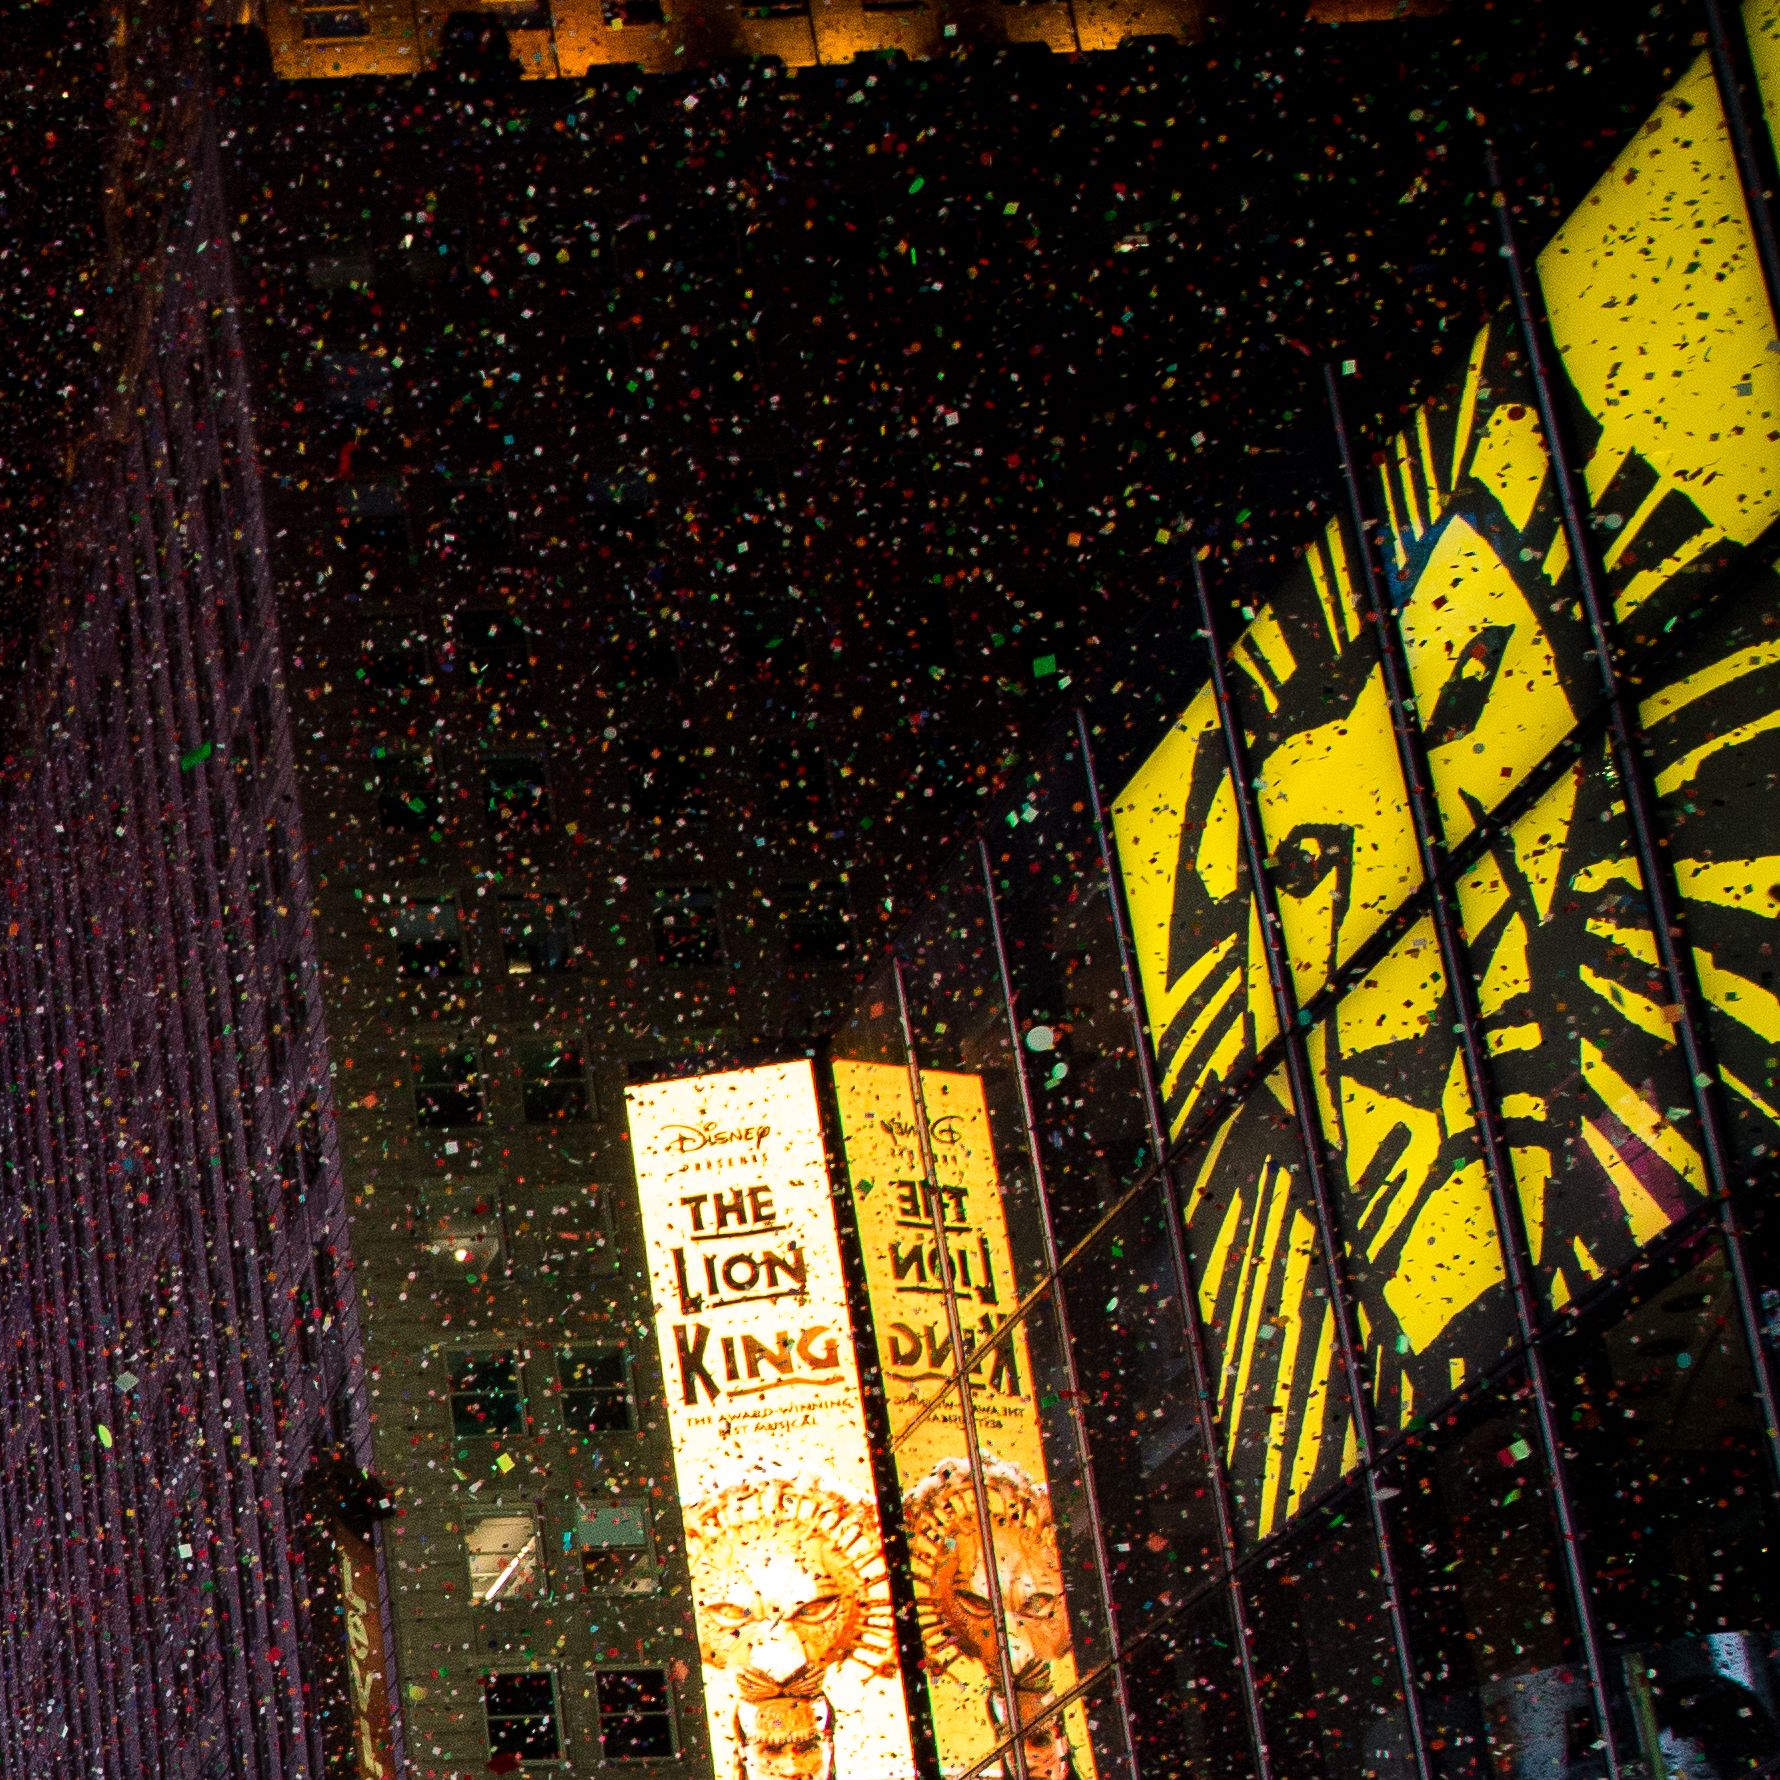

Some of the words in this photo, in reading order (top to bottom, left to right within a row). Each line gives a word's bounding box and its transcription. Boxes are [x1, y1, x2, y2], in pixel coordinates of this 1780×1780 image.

[680, 1185, 777, 1234] THE
[671, 1247, 809, 1316] LION
[672, 1323, 840, 1407] KING
